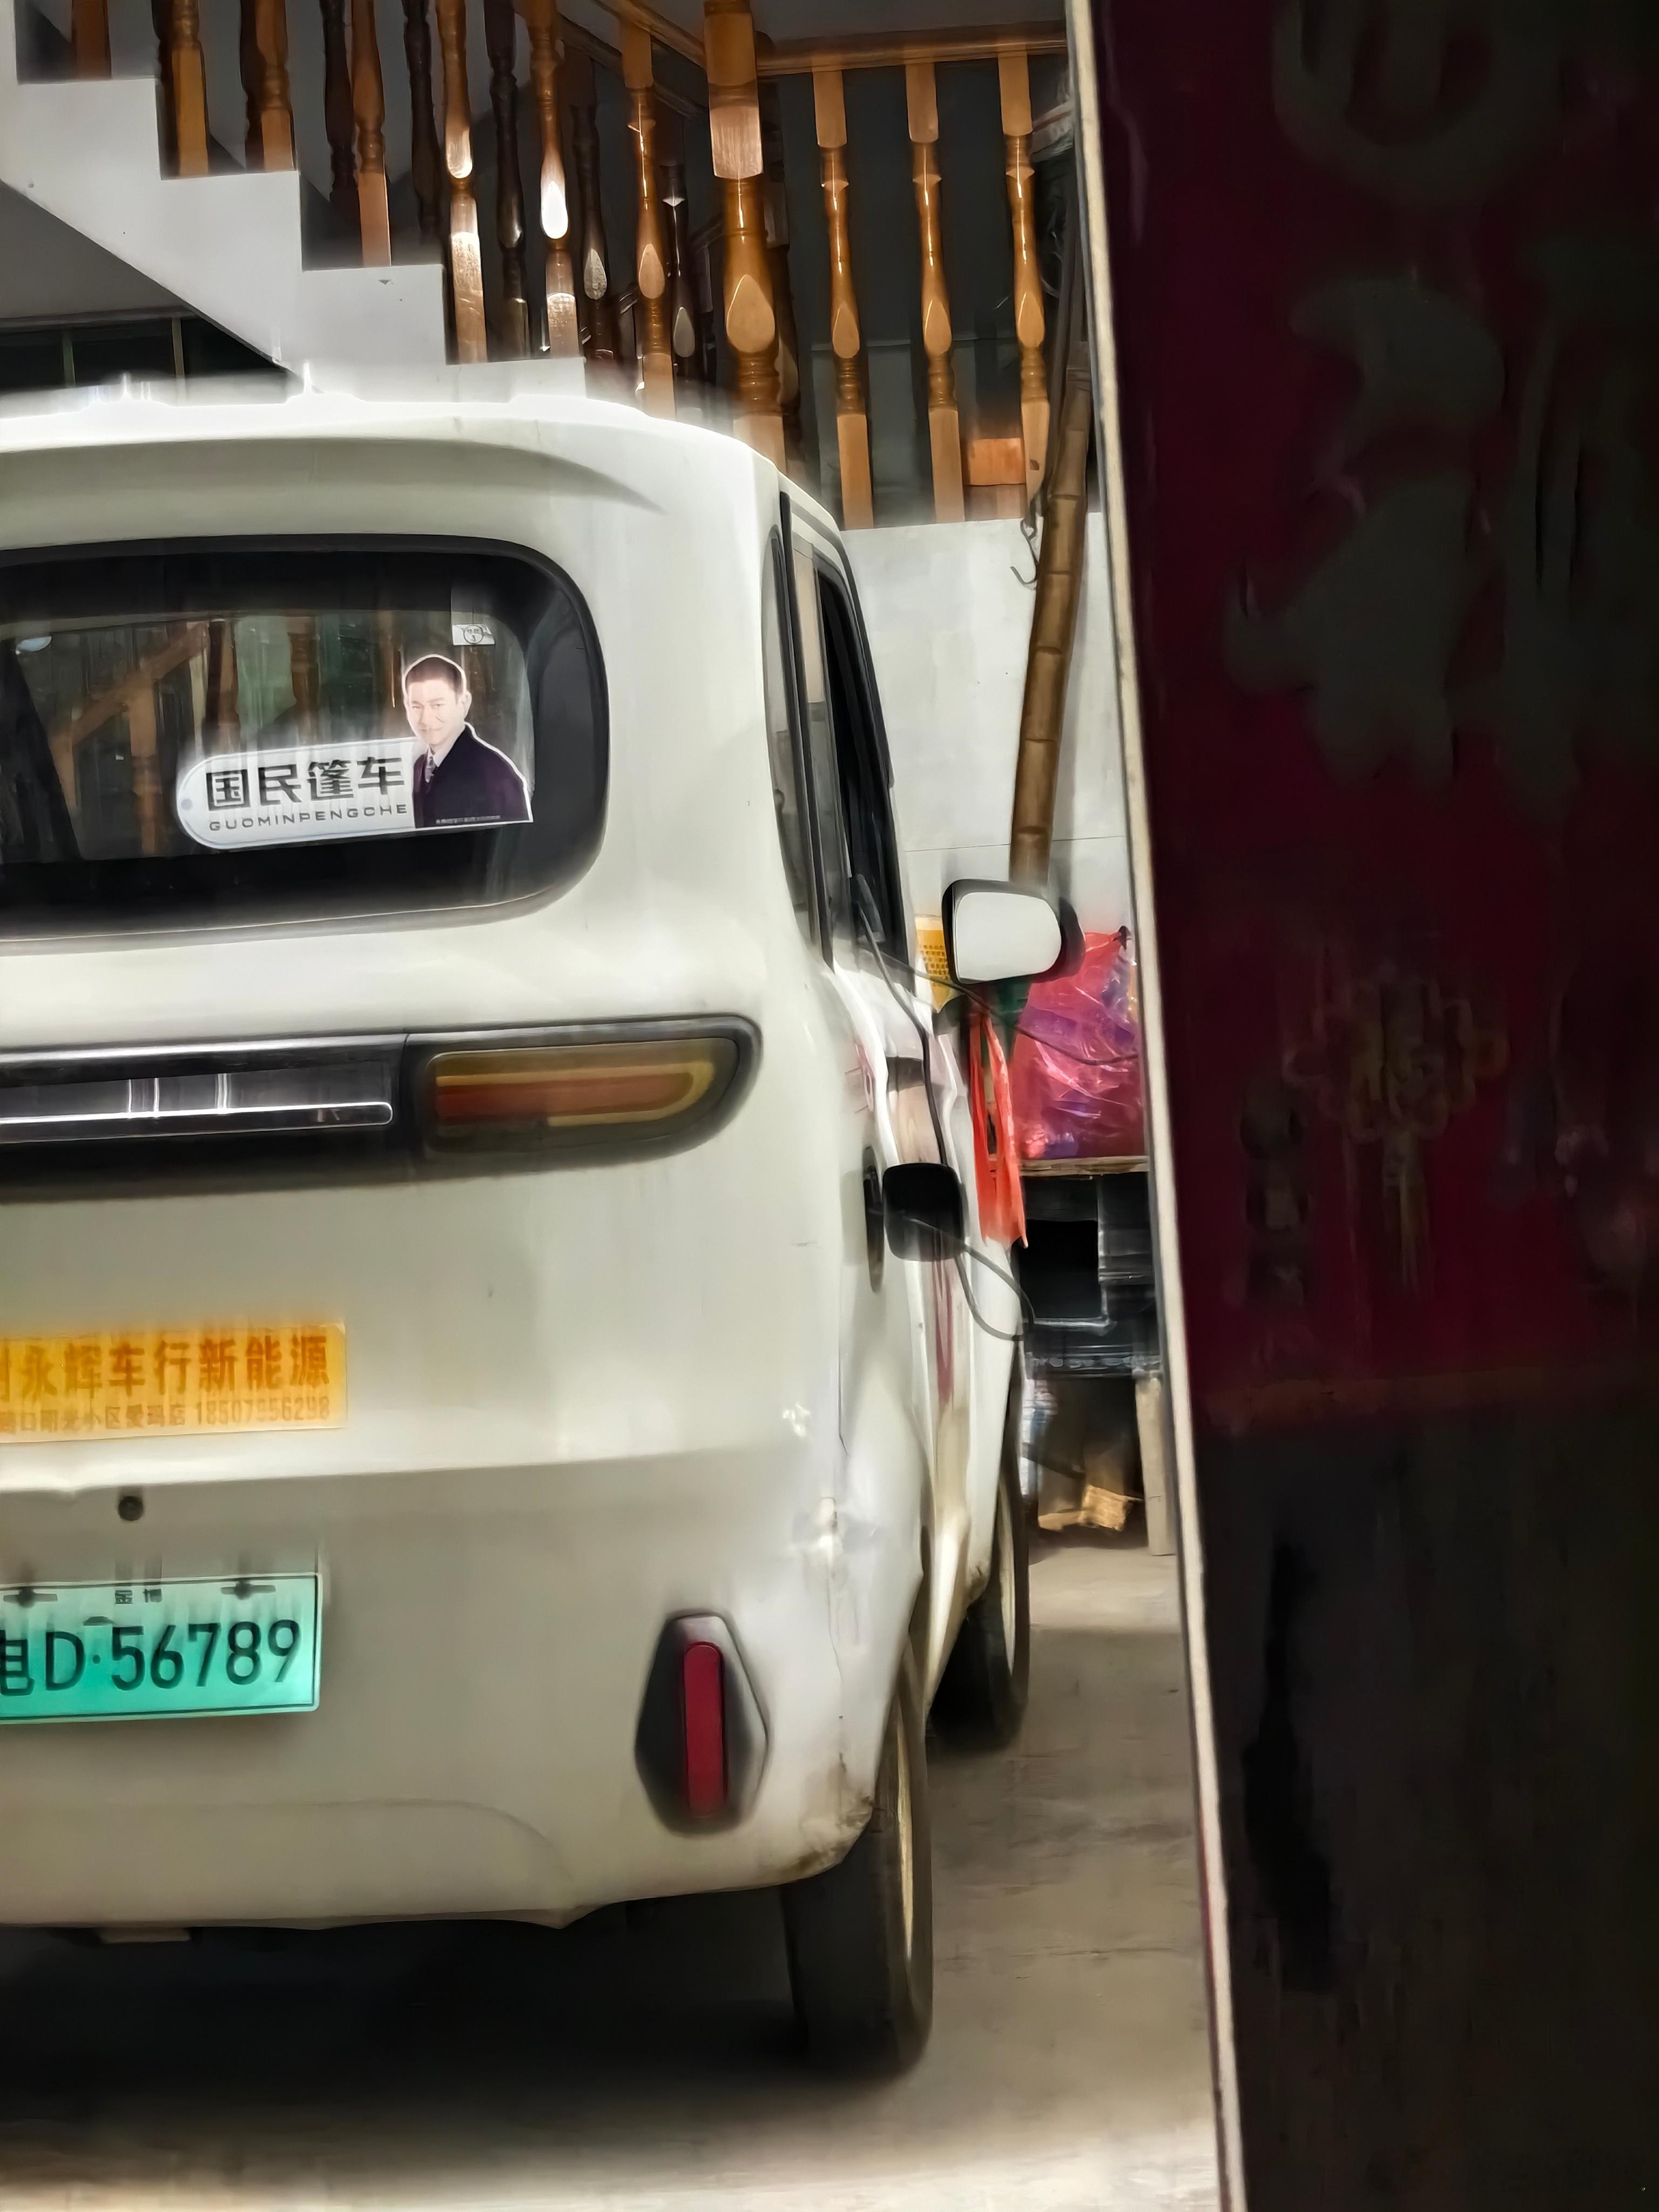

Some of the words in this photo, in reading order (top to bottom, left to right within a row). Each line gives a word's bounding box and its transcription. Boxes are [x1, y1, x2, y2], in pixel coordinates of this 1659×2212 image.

[206, 757, 405, 811] 国民篷车
[209, 804, 407, 832] GUOMINPENGCHE
[0, 1334, 329, 1402] 永辉车行新能源
